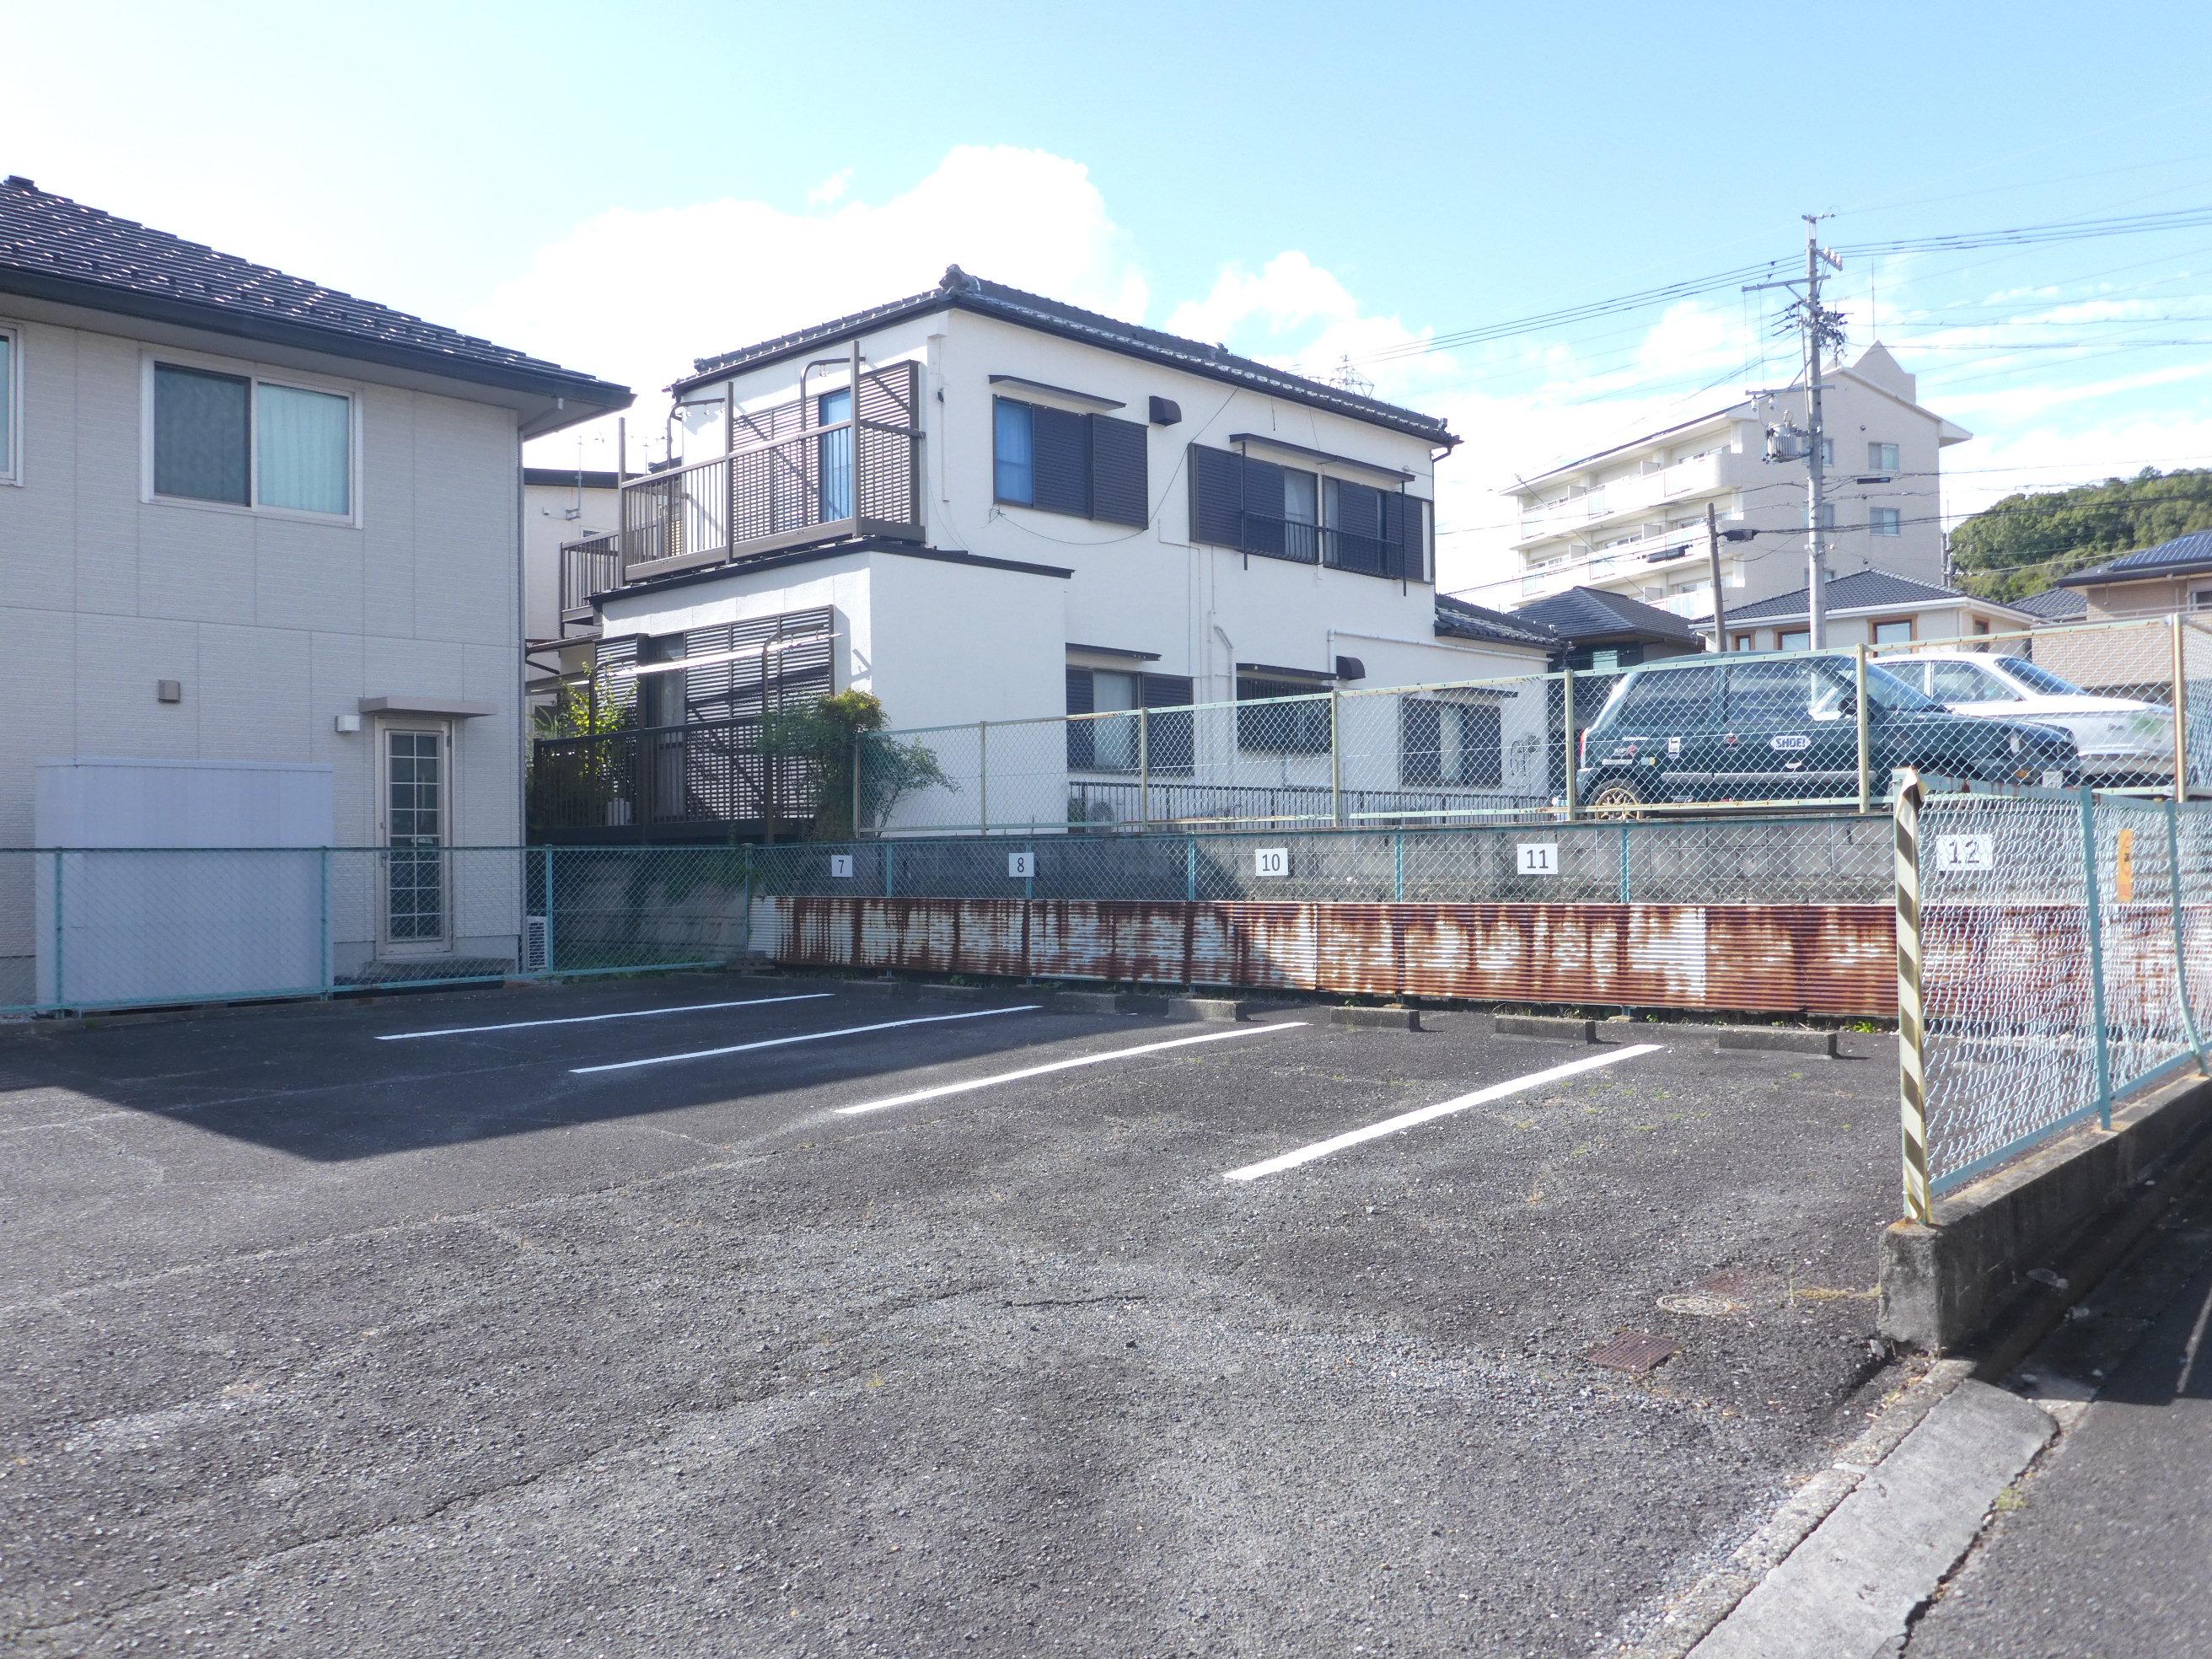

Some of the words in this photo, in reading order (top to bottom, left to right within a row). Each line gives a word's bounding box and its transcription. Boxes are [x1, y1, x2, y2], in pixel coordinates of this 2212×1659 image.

[1527, 849, 1549, 869] 11
[1949, 840, 1980, 864] 12
[838, 859, 845, 874] 7
[1017, 856, 1025, 873] 8
[1262, 853, 1280, 872] 10
